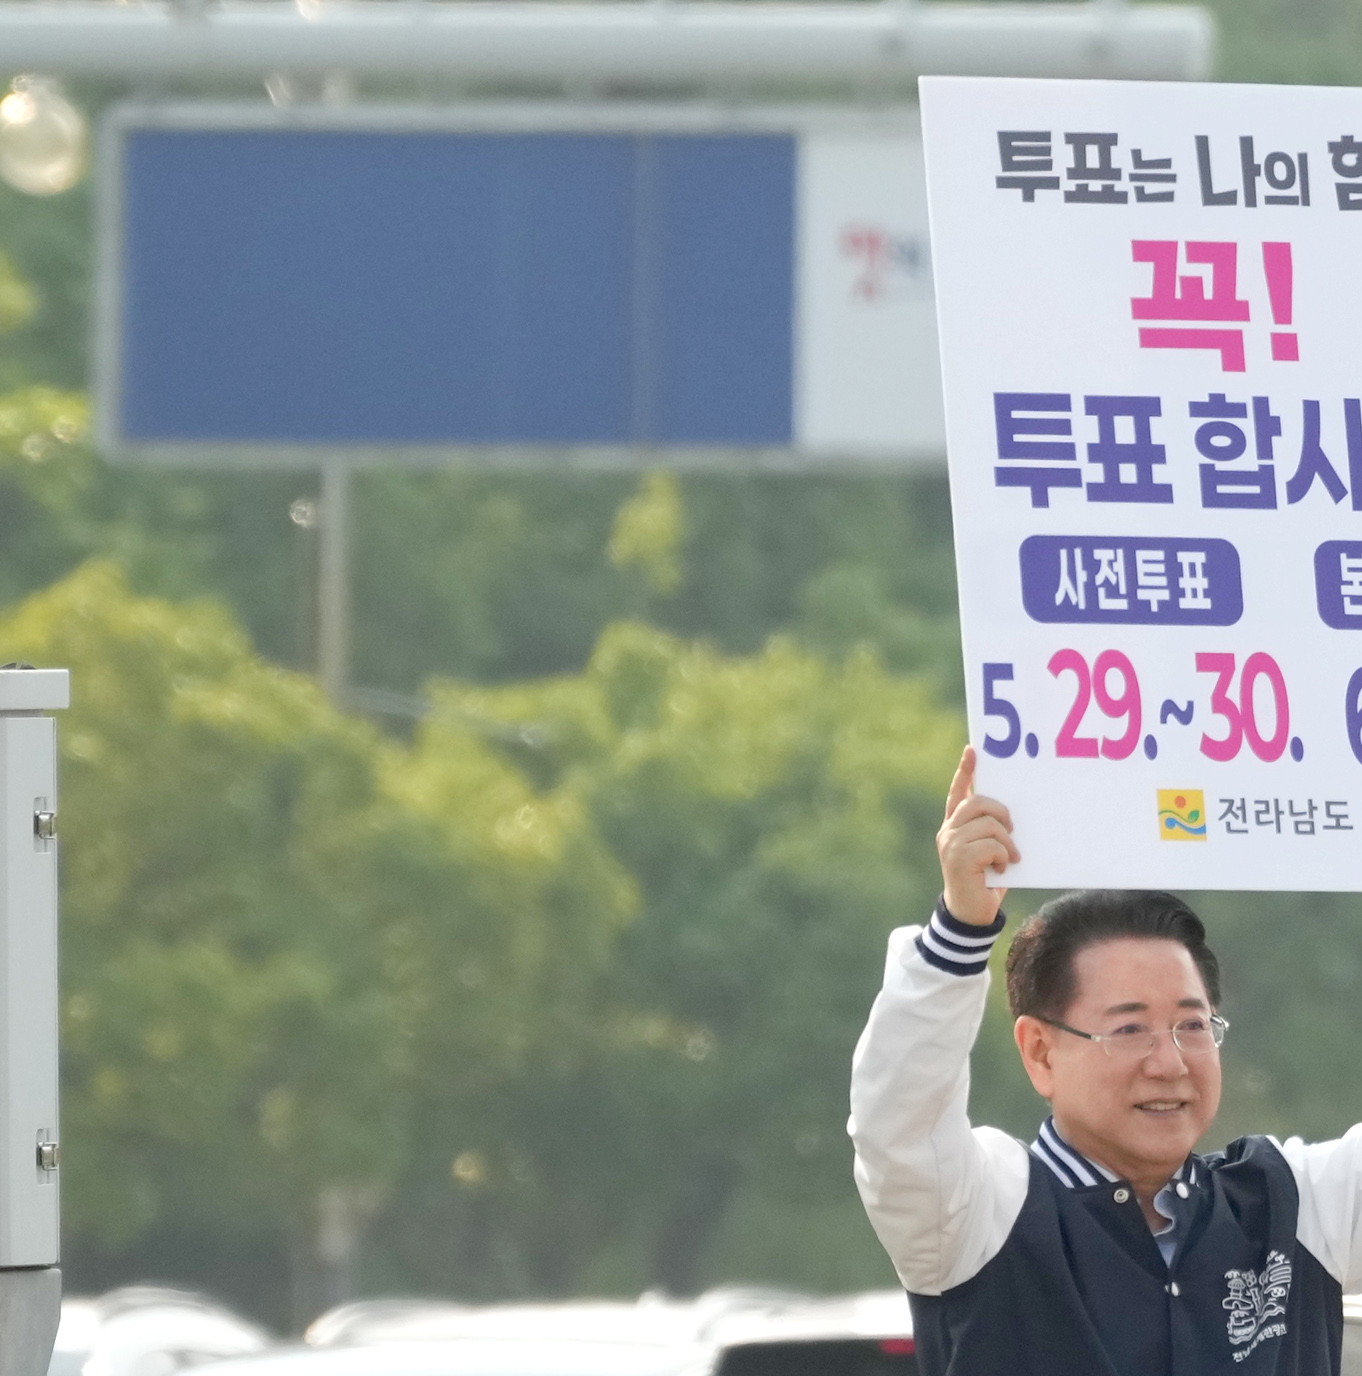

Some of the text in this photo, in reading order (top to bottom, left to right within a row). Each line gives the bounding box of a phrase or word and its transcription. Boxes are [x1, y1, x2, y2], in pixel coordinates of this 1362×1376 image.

[995, 130, 1178, 205] 투표는
[1194, 134, 1311, 208] 나의
[1130, 239, 1300, 373] 꼭!
[993, 391, 1174, 508] 투표
[1054, 547, 1213, 613] 사전투표
[1218, 797, 1354, 836] 전라남도
